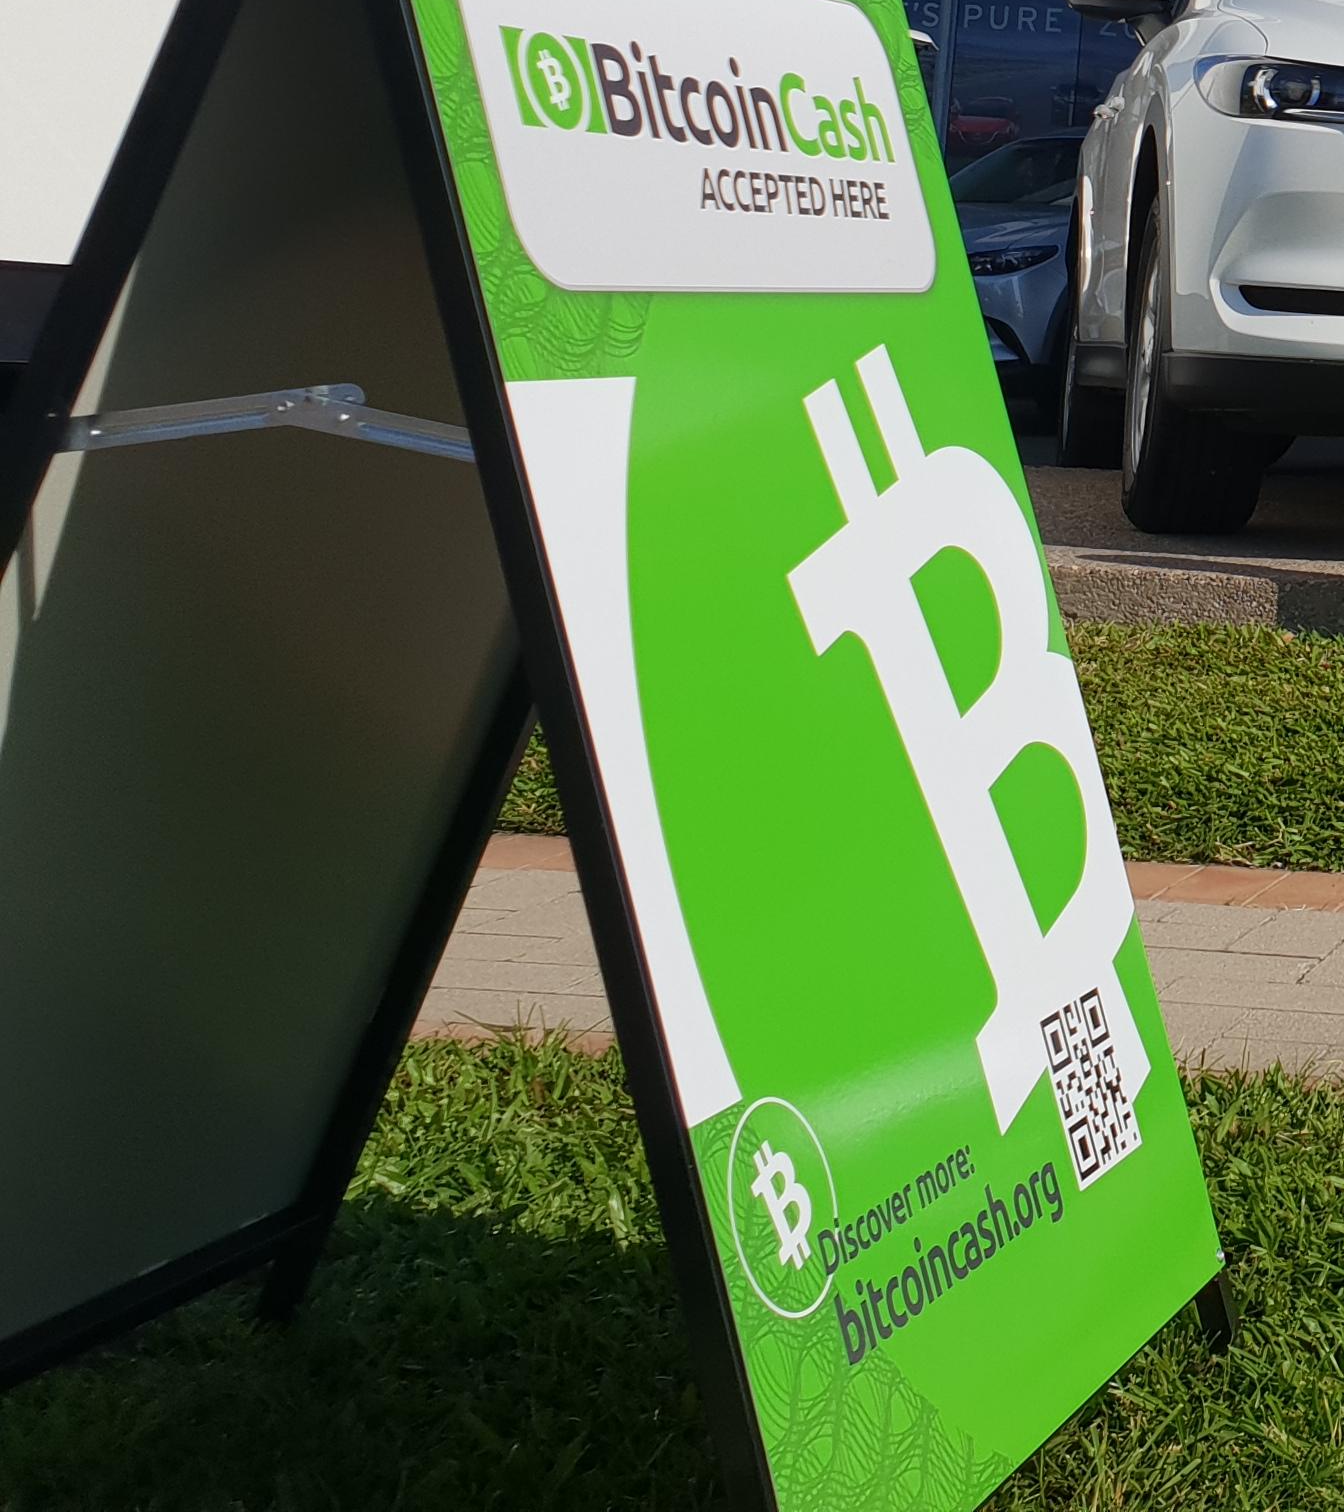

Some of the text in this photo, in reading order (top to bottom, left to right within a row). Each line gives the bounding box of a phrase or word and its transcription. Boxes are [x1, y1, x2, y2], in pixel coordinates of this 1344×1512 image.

[963, 3, 1064, 35] PURE
[590, 40, 896, 165] BitcoinCash
[700, 167, 891, 221] ACCEPTED HERE
[816, 1144, 976, 1276] Discover more:
[833, 1161, 1065, 1367] bitcoincash.org
